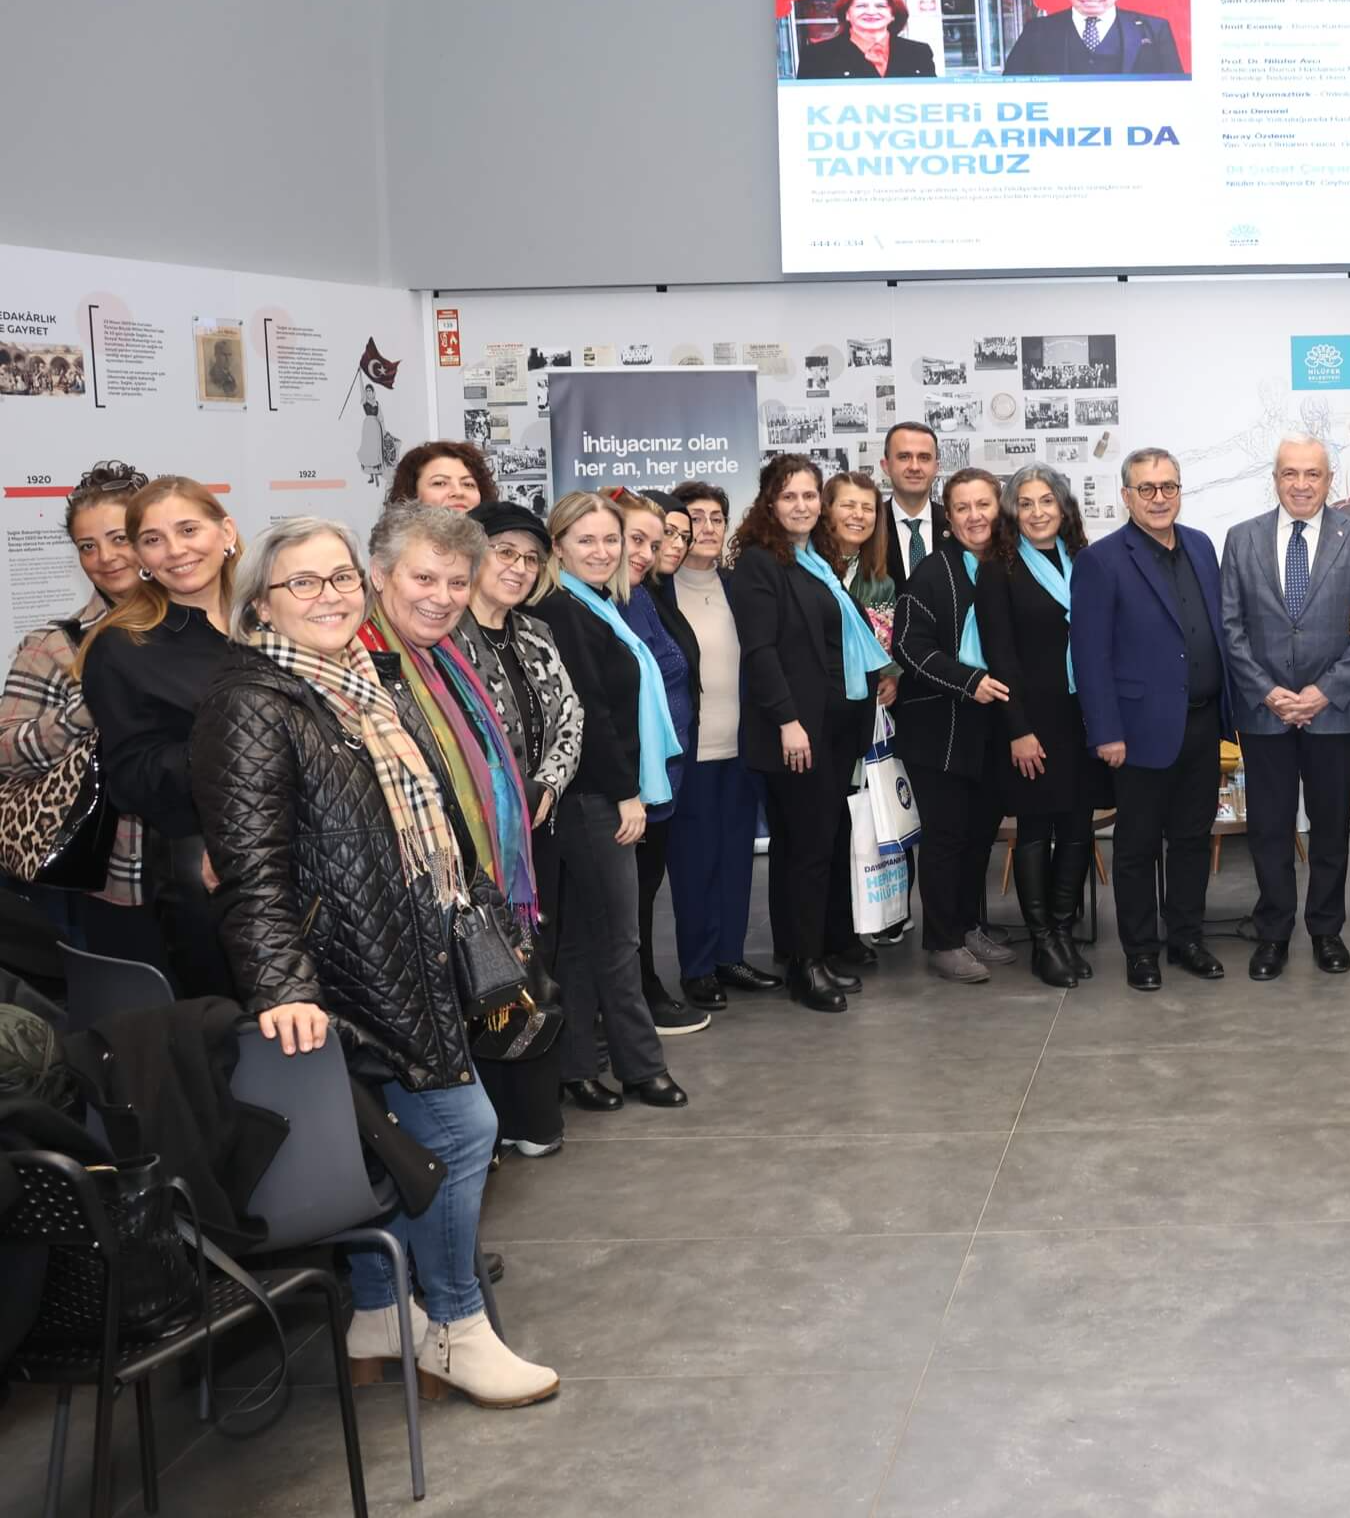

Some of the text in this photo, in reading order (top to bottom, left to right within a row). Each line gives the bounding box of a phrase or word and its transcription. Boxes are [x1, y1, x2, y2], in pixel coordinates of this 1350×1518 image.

[998, 102, 1049, 122] DE
[808, 126, 1181, 151] DUYGULARINIZI DA
[808, 154, 1030, 177] TANIYORUZ
[7, 324, 49, 336] GAYRET
[583, 431, 729, 457] İhtiyacınız olan
[299, 470, 317, 478] 1922
[574, 457, 739, 479] her an, her yerde
[27, 475, 52, 484] 1920
